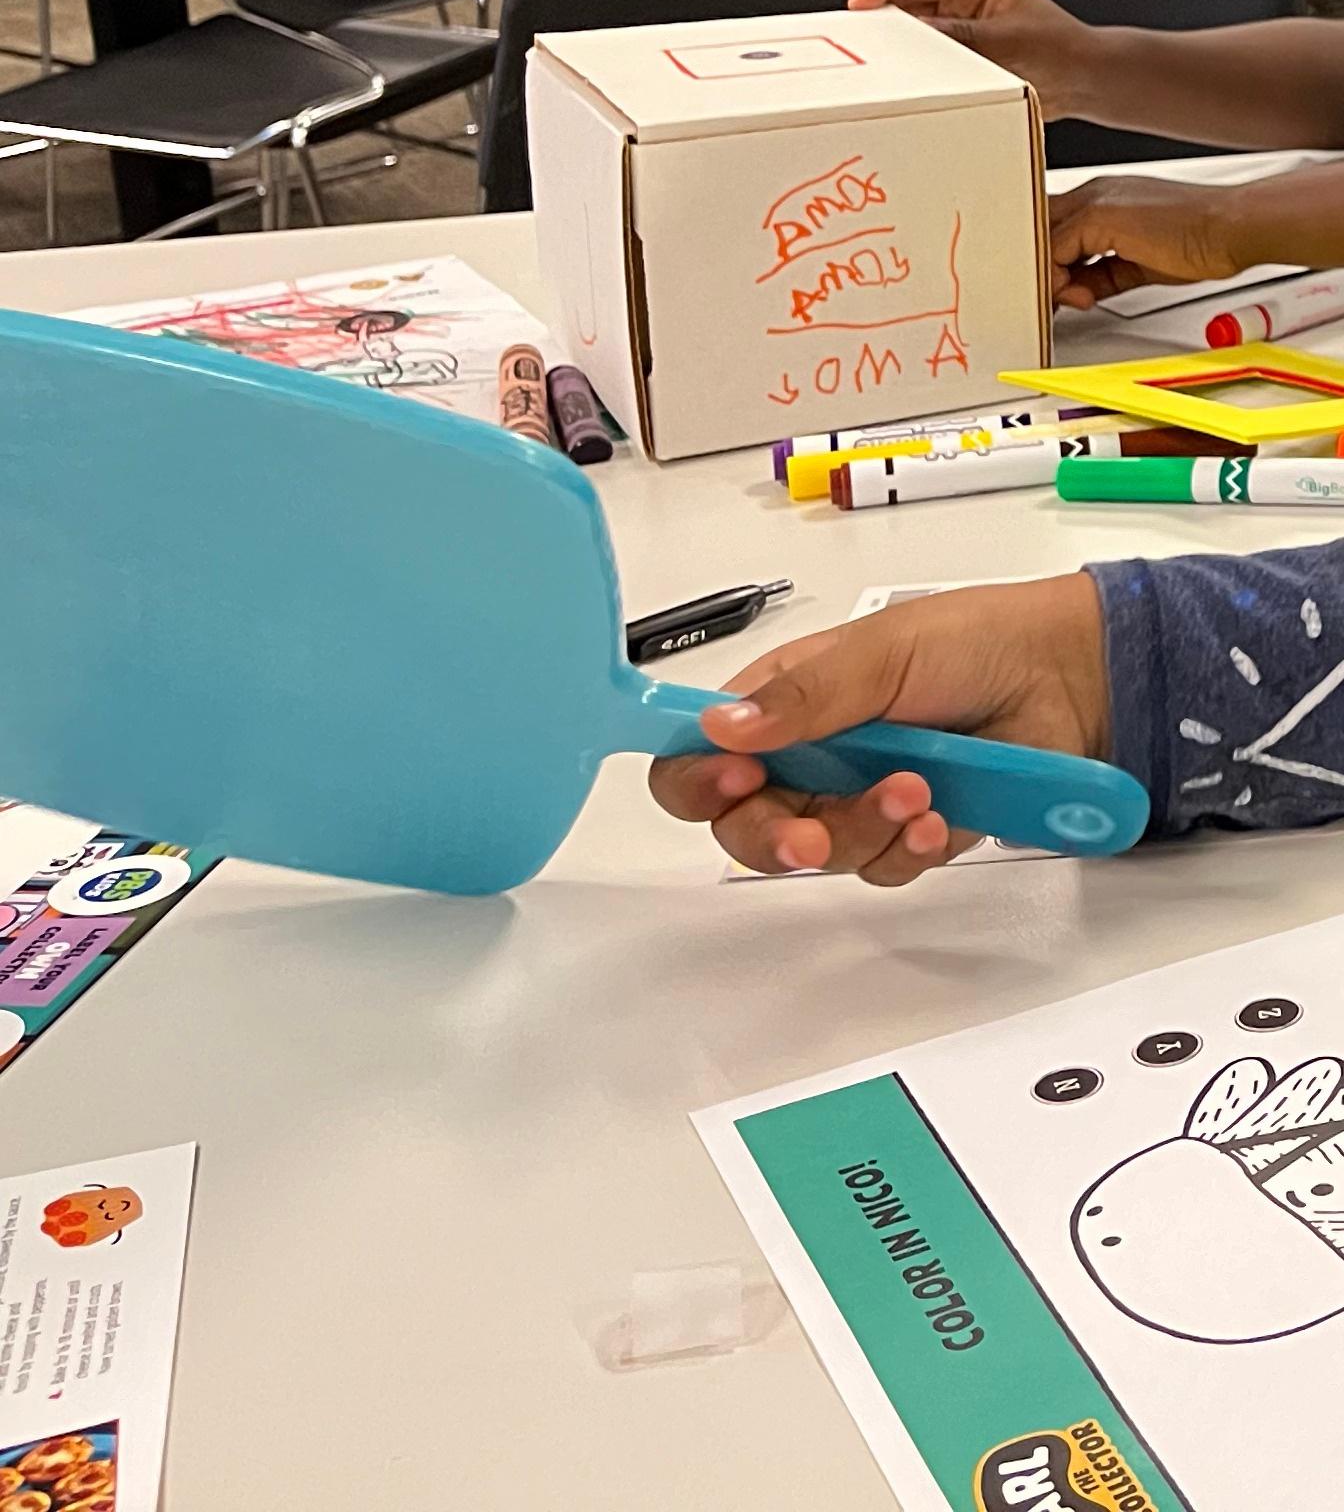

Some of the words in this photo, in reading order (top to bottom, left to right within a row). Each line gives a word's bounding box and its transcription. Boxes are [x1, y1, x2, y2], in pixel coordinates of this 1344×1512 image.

[102, 871, 154, 900] PBS
[64, 928, 108, 959] LABEL
[15, 942, 70, 980] OWN
[30, 963, 71, 991] YOUR
[1156, 1039, 1182, 1055] Y
[1053, 1078, 1080, 1094] N
[838, 1159, 912, 1230] NICO!
[880, 1228, 931, 1262] IN
[902, 1258, 985, 1351] COLOR
[1071, 1422, 1154, 1512] OLLECTOR
[1073, 1468, 1100, 1494] THE
